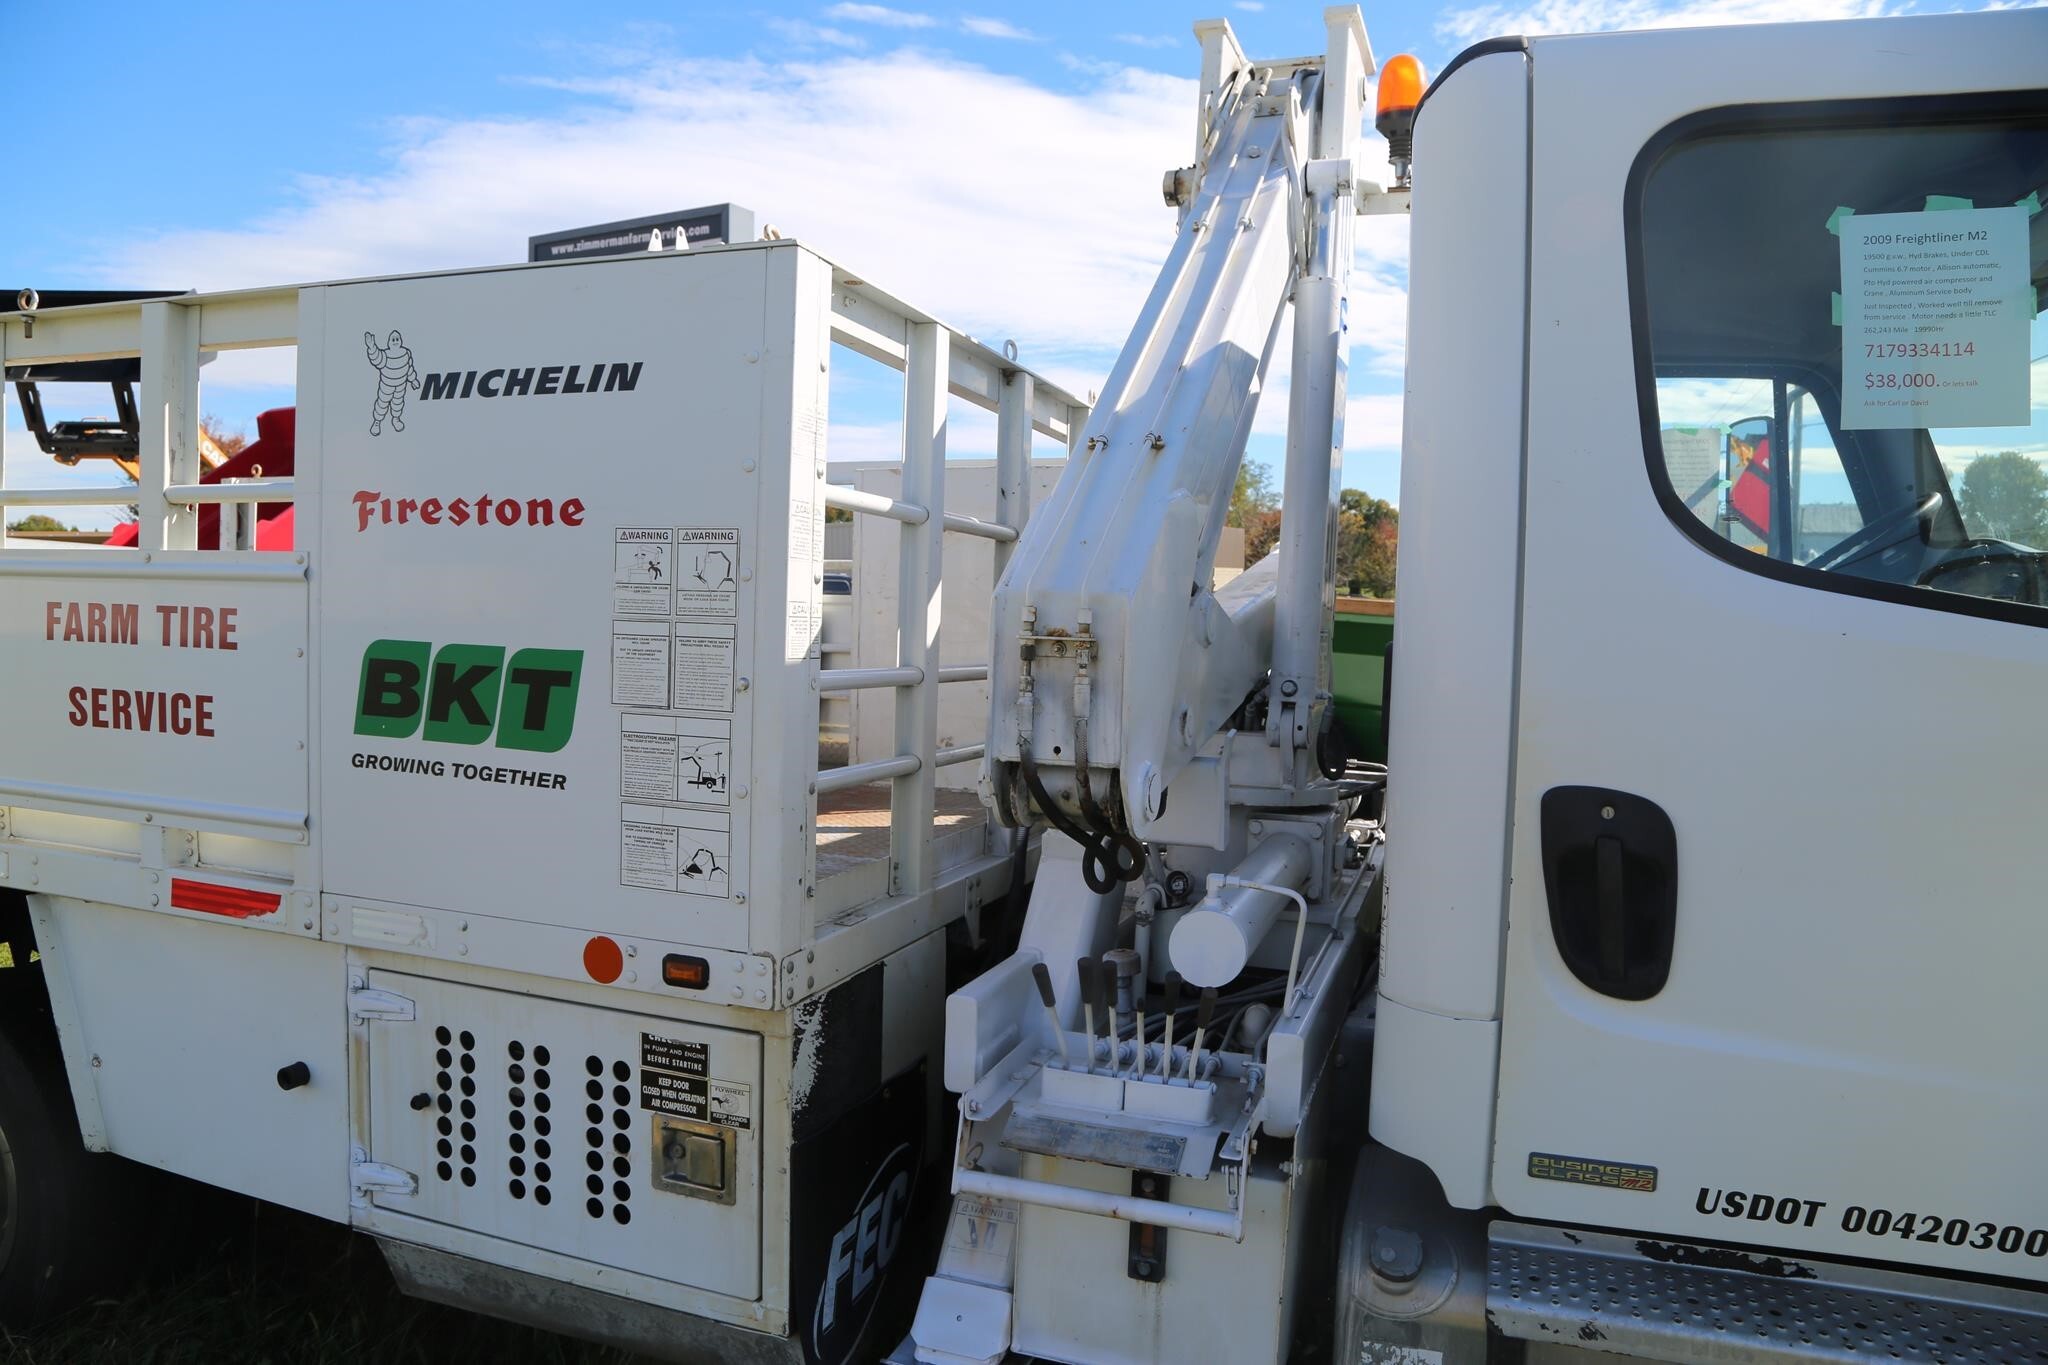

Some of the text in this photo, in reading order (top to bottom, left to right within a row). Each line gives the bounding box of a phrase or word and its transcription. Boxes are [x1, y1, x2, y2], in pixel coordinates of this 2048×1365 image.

[550, 225, 709, 256] www.zimmermanfarmrvi.com
[1864, 231, 1987, 245] 2009 Freightliner M2
[1877, 279, 1890, 287] Hyd
[1935, 276, 1977, 285] compressor
[1926, 288, 1952, 296] Service
[1954, 287, 1972, 296] body
[1865, 342, 1975, 358] 7179334114
[419, 362, 643, 401] MICHELIN
[353, 490, 585, 532] Firestone
[628, 531, 669, 541] WARNING
[691, 532, 734, 541] WARNING
[47, 602, 238, 650] FARM TIRE
[362, 658, 573, 731] BKT
[68, 686, 215, 737] SERVICE
[351, 753, 567, 790] GROWING TOGETHER
[652, 1044, 667, 1053] PUMP
[684, 1051, 705, 1060] ENGINE
[647, 1054, 702, 1071] BEFORE STARTING
[658, 1077, 690, 1090] KEEP DOOR
[715, 1087, 745, 1097] FLYWHEEL
[642, 1085, 706, 1105] CLOSED WHEN OPERATING
[651, 1098, 697, 1114] AIR COMPRESSOR
[713, 1112, 748, 1123] KEEP HANDS
[721, 1119, 740, 1127] CLEAR
[1532, 1157, 1654, 1179] BUSINESS
[1532, 1168, 1619, 1185] CLASS
[1695, 1187, 2048, 1258] USDOT 00420300
[822, 1170, 908, 1335] FEC
